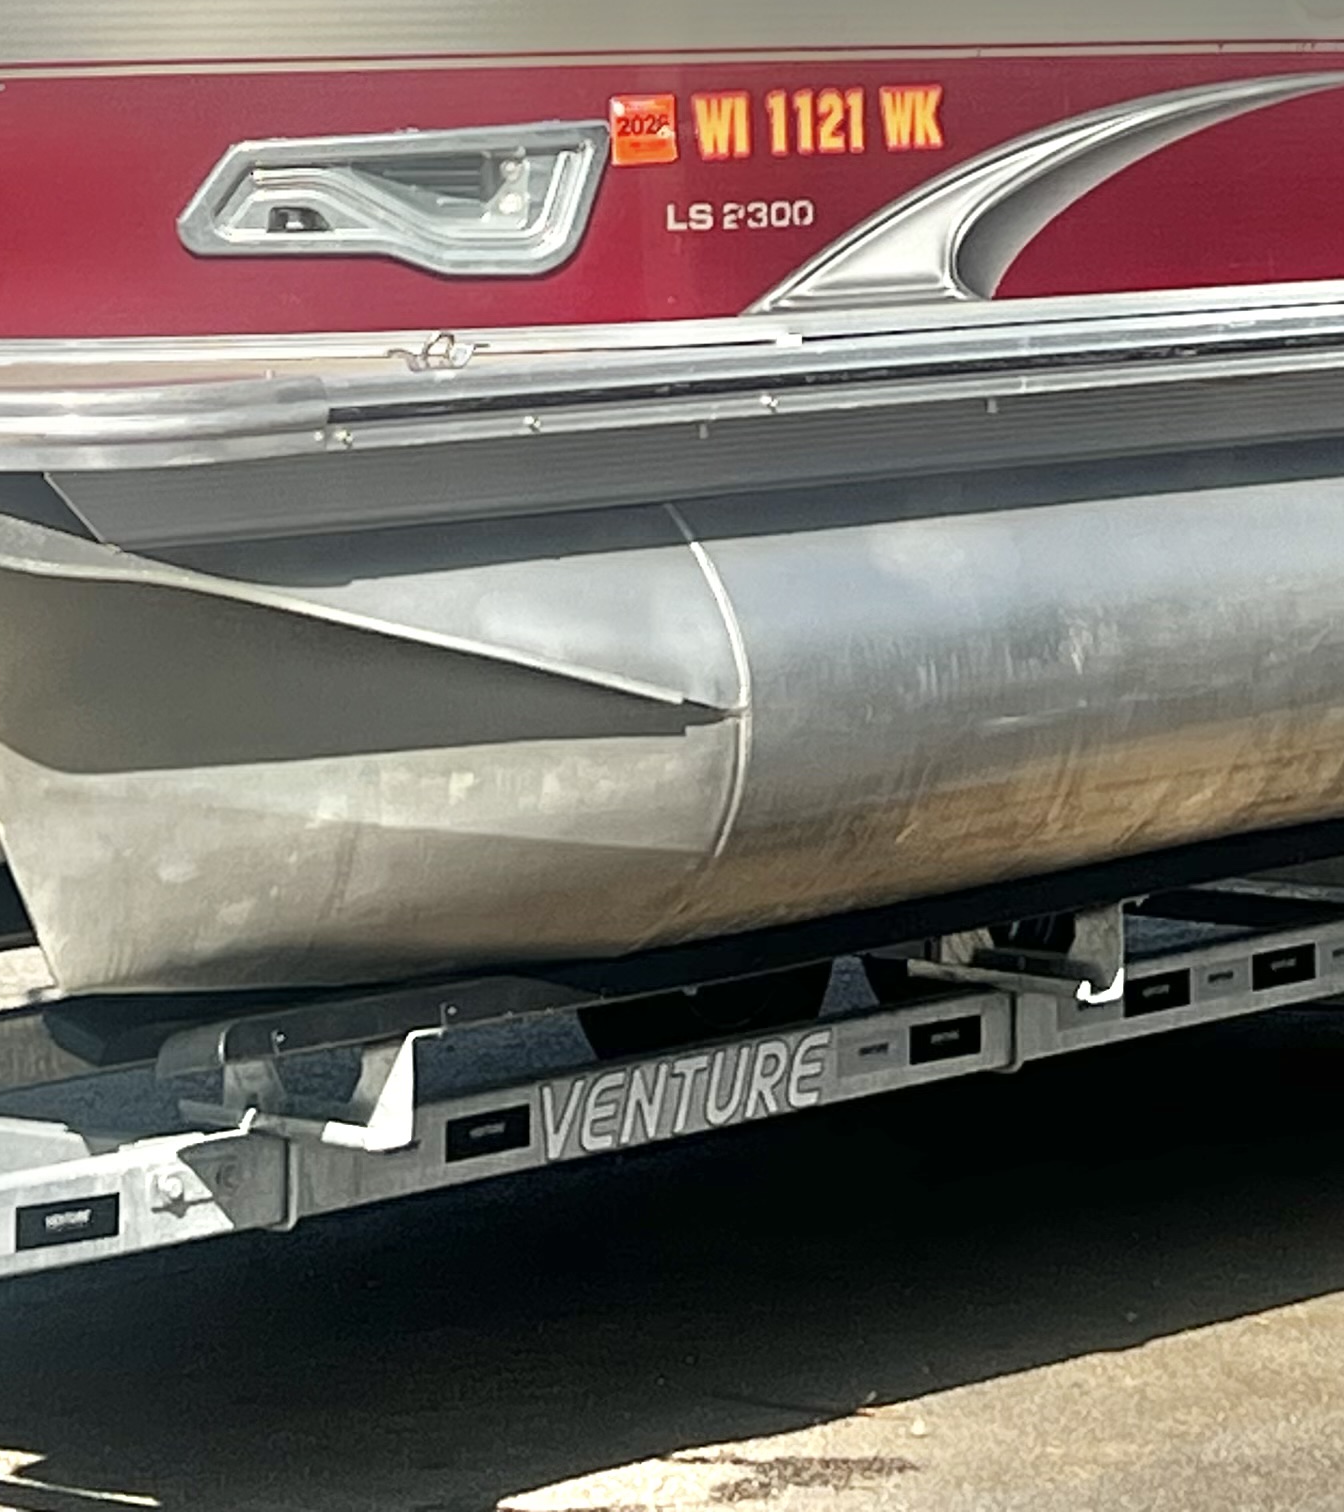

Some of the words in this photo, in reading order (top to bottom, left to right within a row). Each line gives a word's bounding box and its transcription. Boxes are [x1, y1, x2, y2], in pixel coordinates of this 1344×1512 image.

[692, 90, 751, 161] WI
[766, 86, 864, 156] 1121
[878, 84, 943, 149] WK
[666, 203, 714, 231] LS
[723, 199, 814, 230] 2300
[539, 1028, 832, 1160] VENTURE
